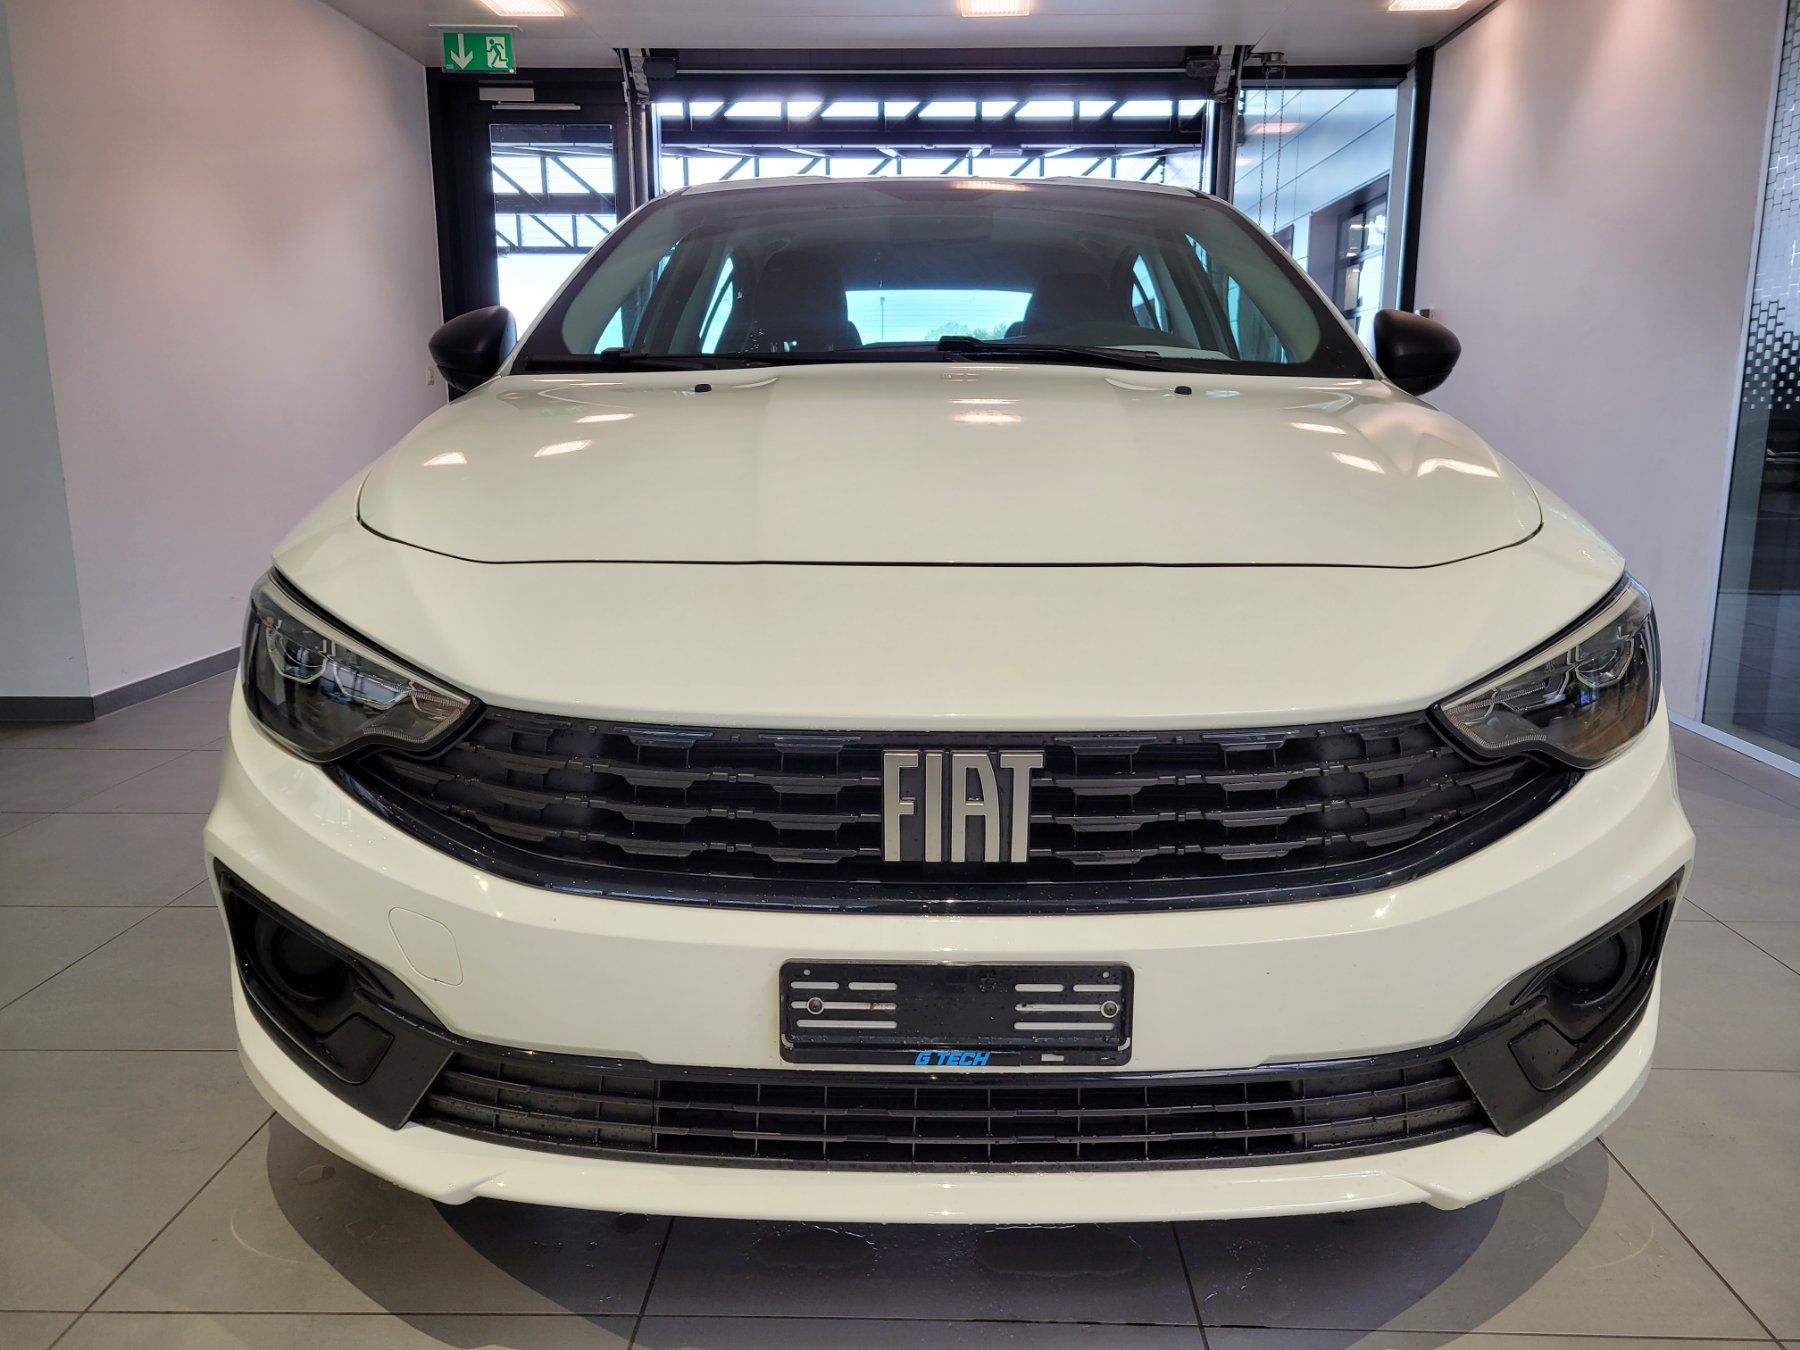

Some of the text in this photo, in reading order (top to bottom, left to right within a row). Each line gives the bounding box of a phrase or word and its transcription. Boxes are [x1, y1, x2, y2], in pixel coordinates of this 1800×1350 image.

[883, 752, 1044, 863] FIAT
[914, 1051, 991, 1066] G TECH
